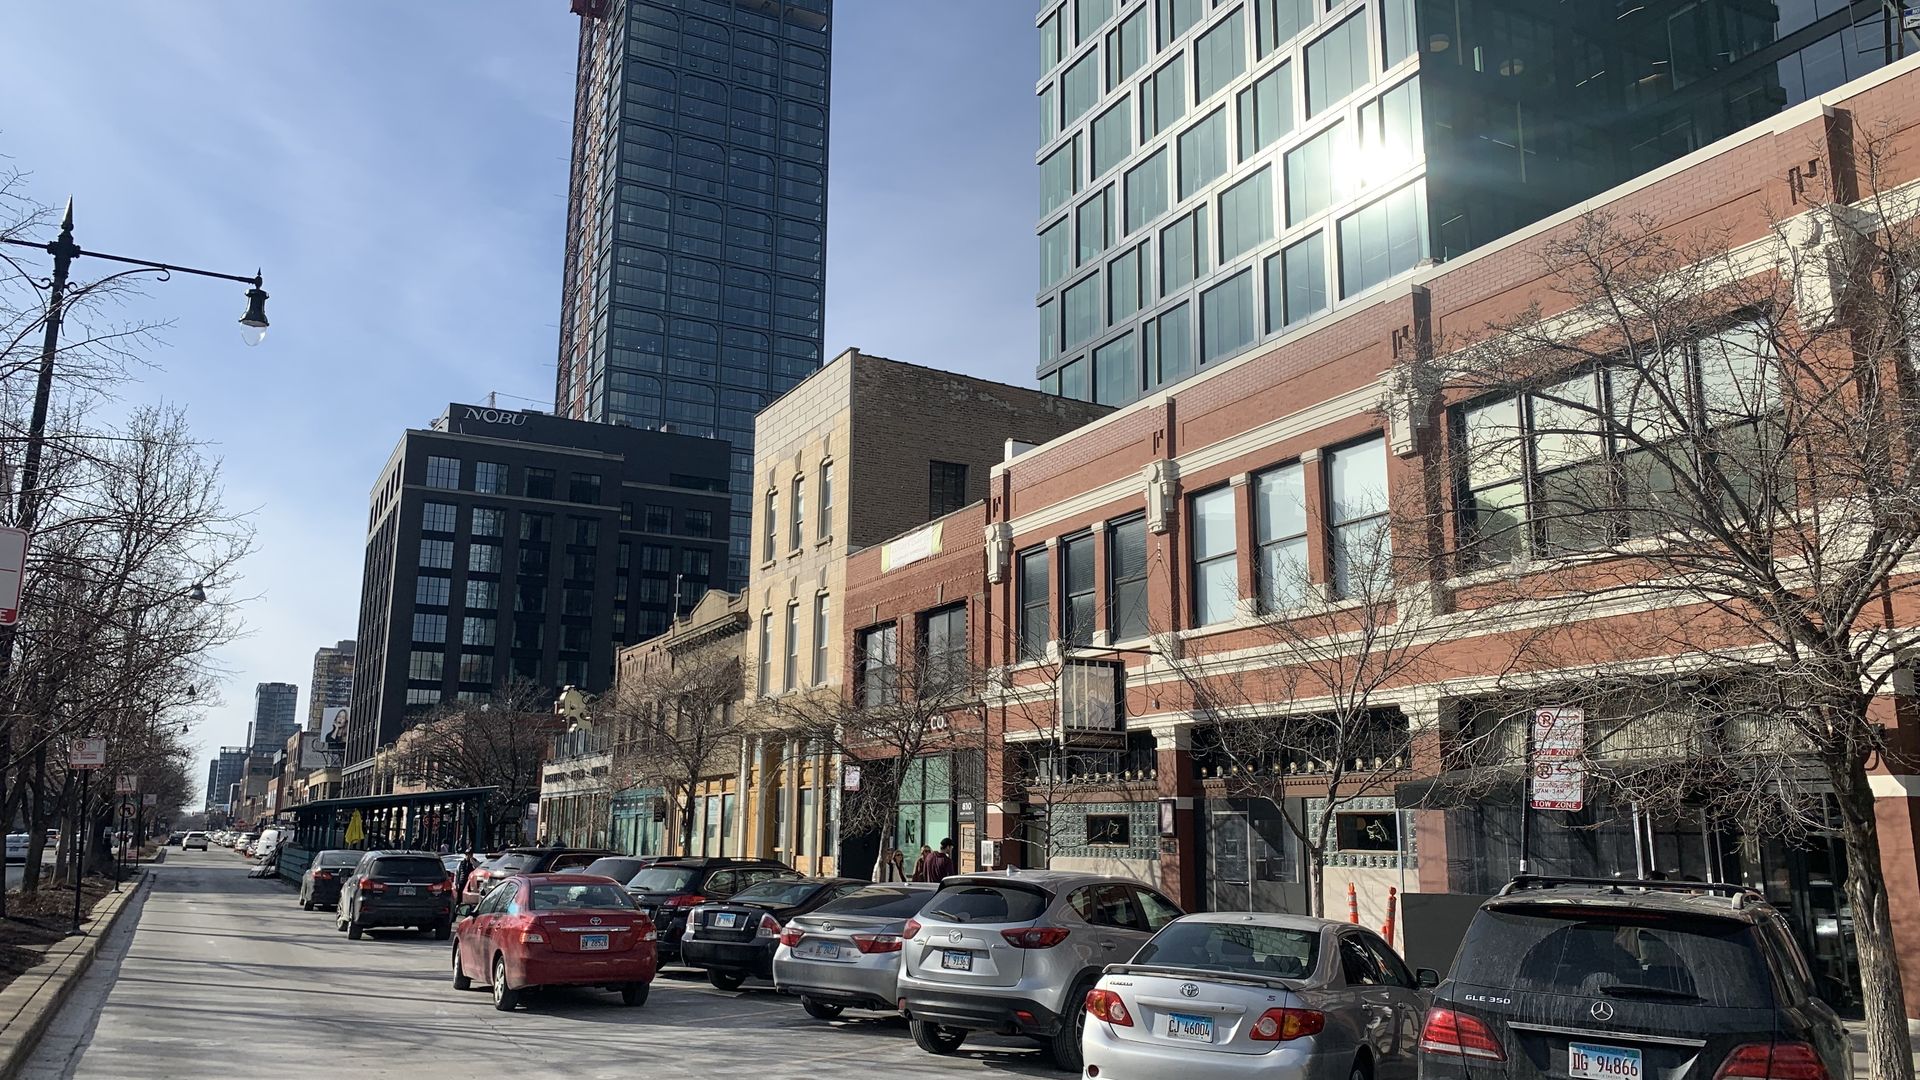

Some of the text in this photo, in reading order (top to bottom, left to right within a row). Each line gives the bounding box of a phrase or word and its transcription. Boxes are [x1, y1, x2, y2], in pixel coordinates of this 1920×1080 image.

[464, 406, 528, 426] NOBU
[930, 715, 948, 730] CO.
[1534, 800, 1578, 809] TOW ZONE
[1465, 994, 1511, 1004] GLE 350
[1169, 1019, 1210, 1037] CJ 46004
[1572, 1052, 1638, 1077] DG 94866
